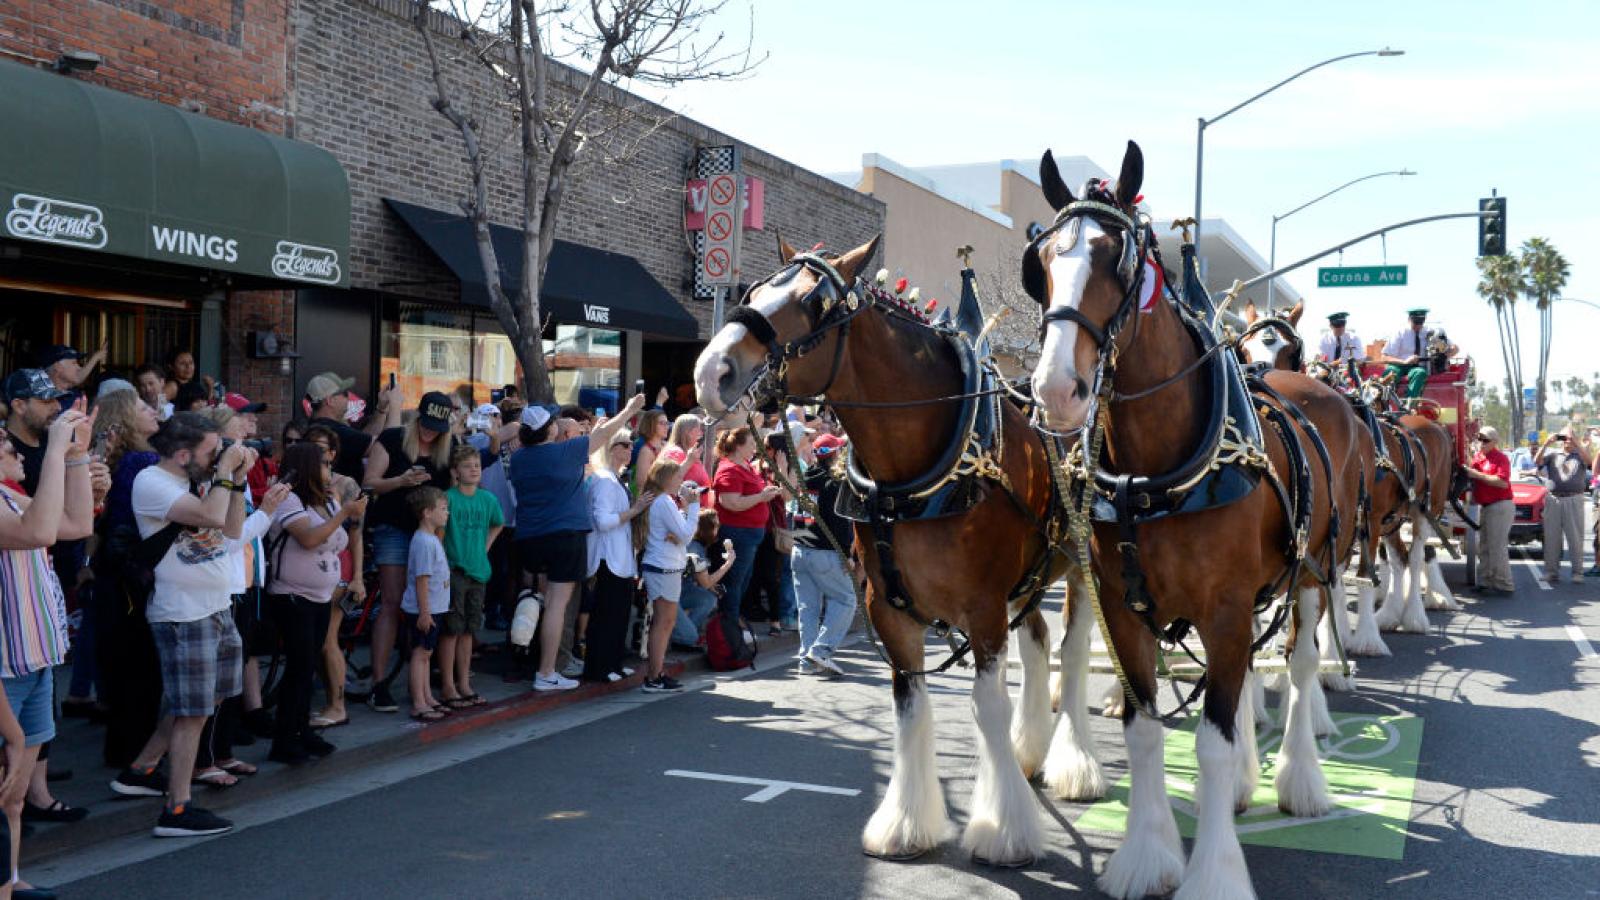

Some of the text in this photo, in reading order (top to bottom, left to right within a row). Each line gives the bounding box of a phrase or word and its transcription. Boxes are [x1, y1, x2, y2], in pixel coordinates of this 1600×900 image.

[12, 200, 98, 239] Legends
[152, 225, 239, 263] WINGS
[1322, 270, 1403, 282] Corona Ave
[583, 303, 610, 324] VANS
